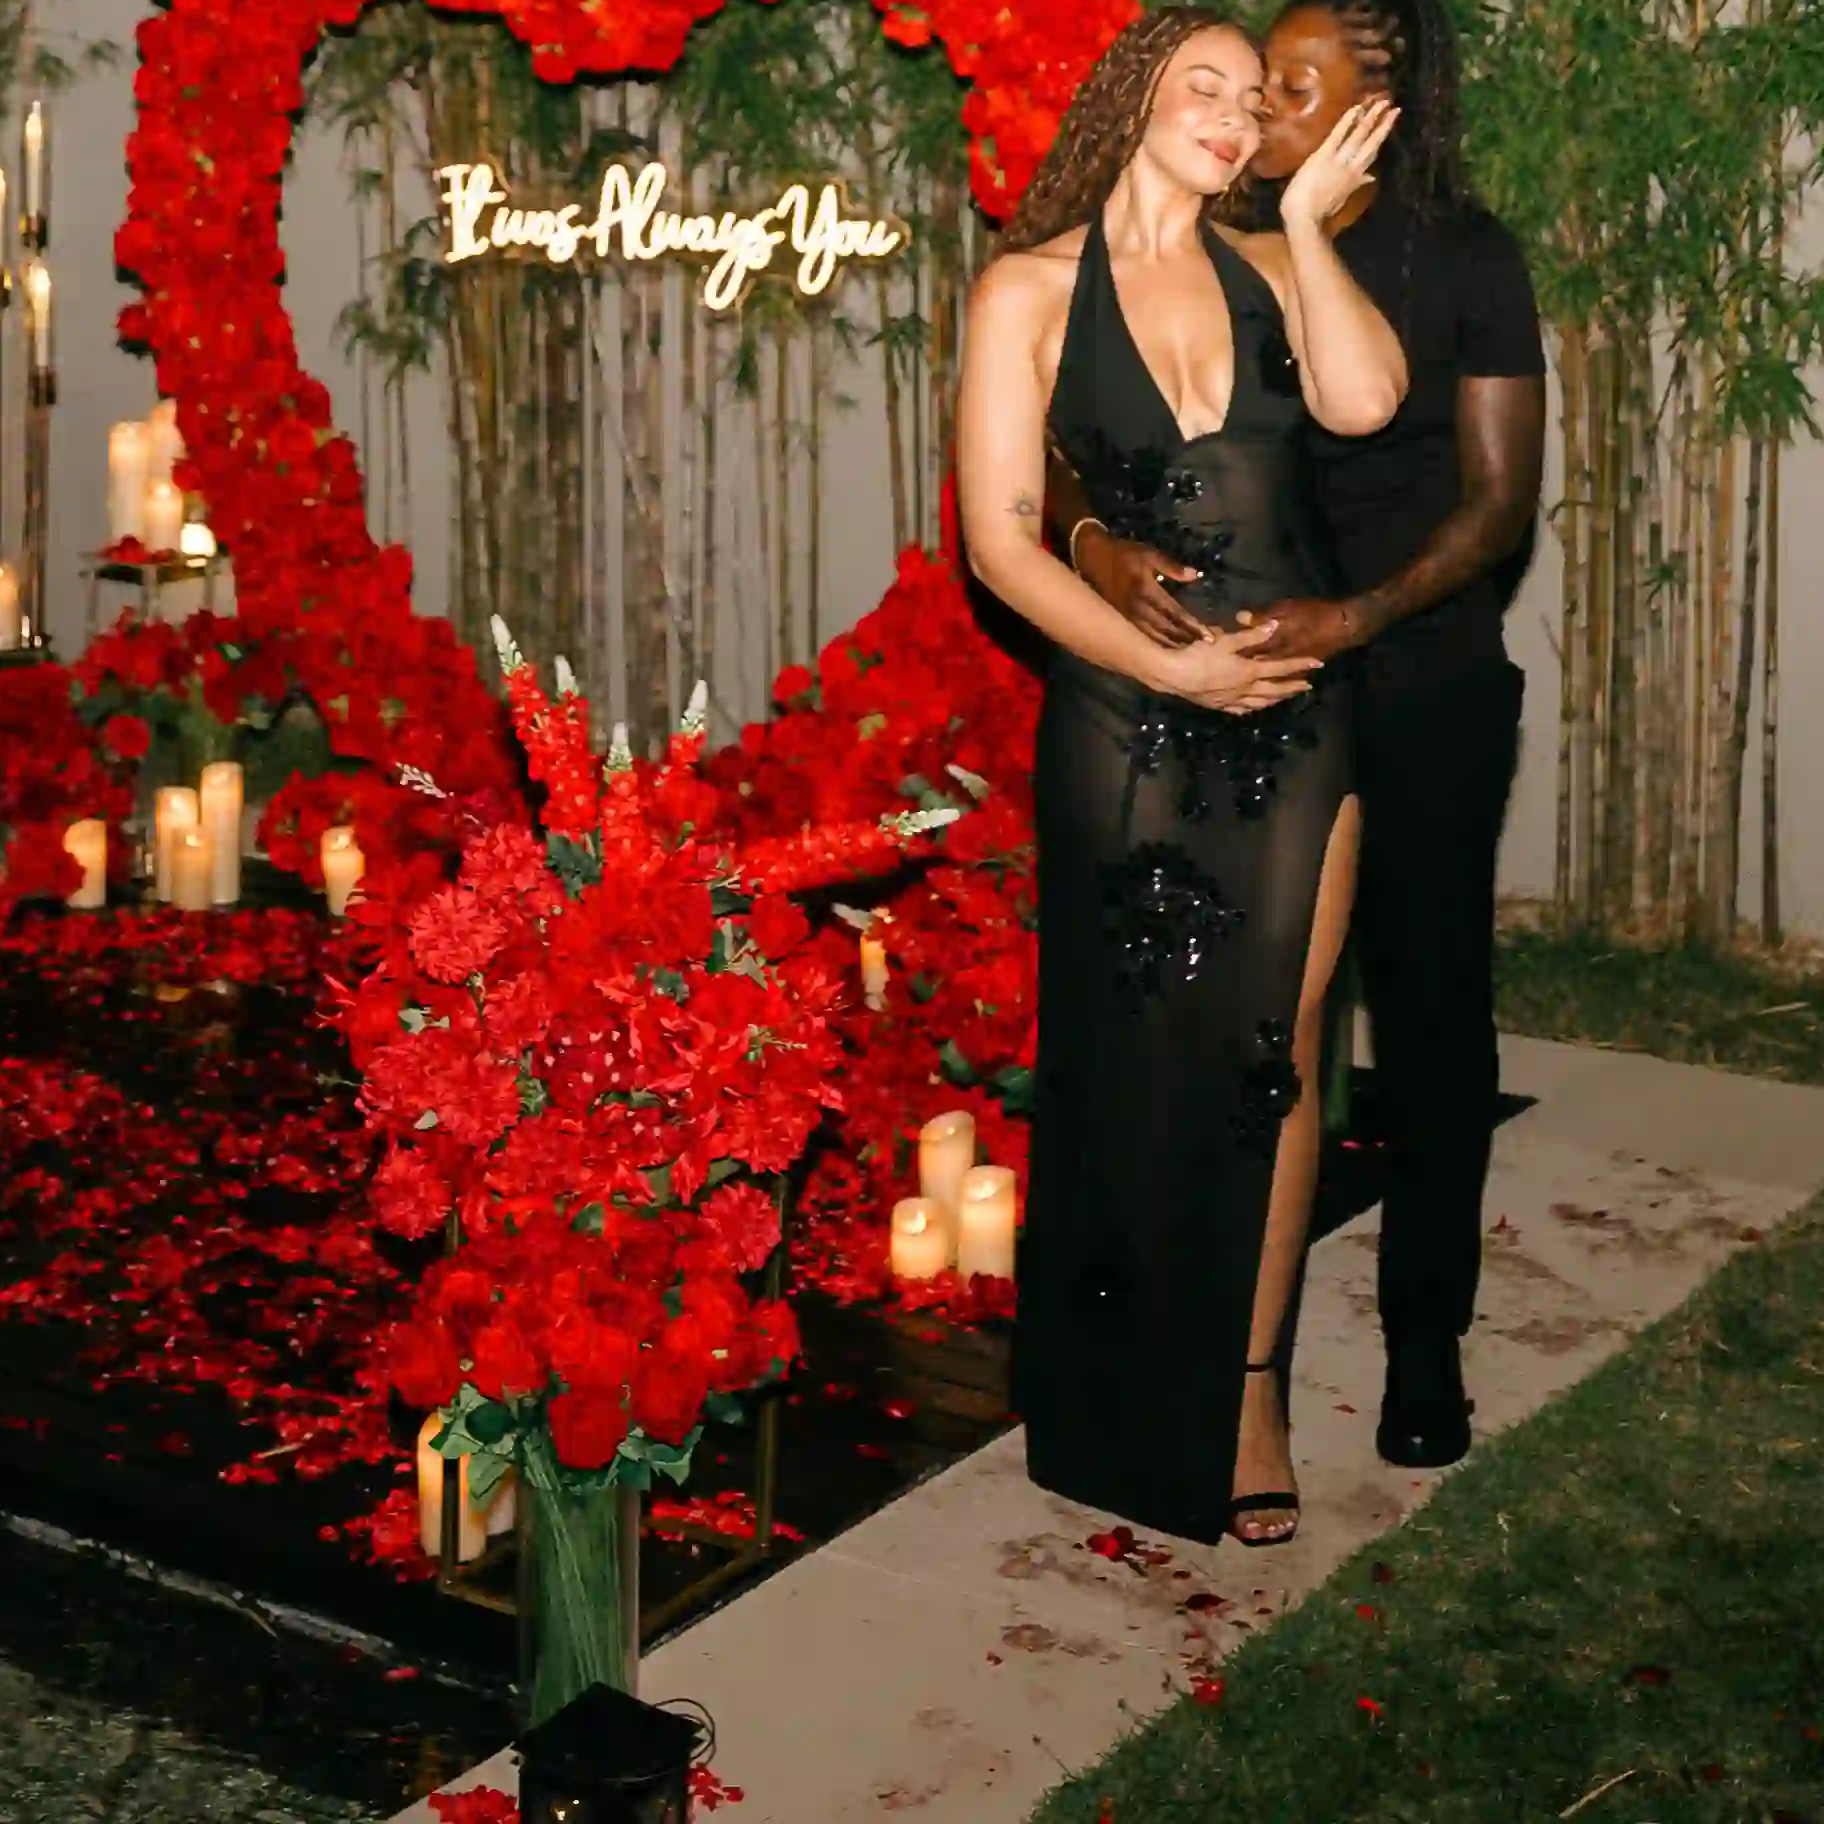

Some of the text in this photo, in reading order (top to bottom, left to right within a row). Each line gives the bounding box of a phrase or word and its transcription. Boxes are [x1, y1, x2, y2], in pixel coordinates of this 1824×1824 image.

[440, 162, 899, 310] It was Always You
